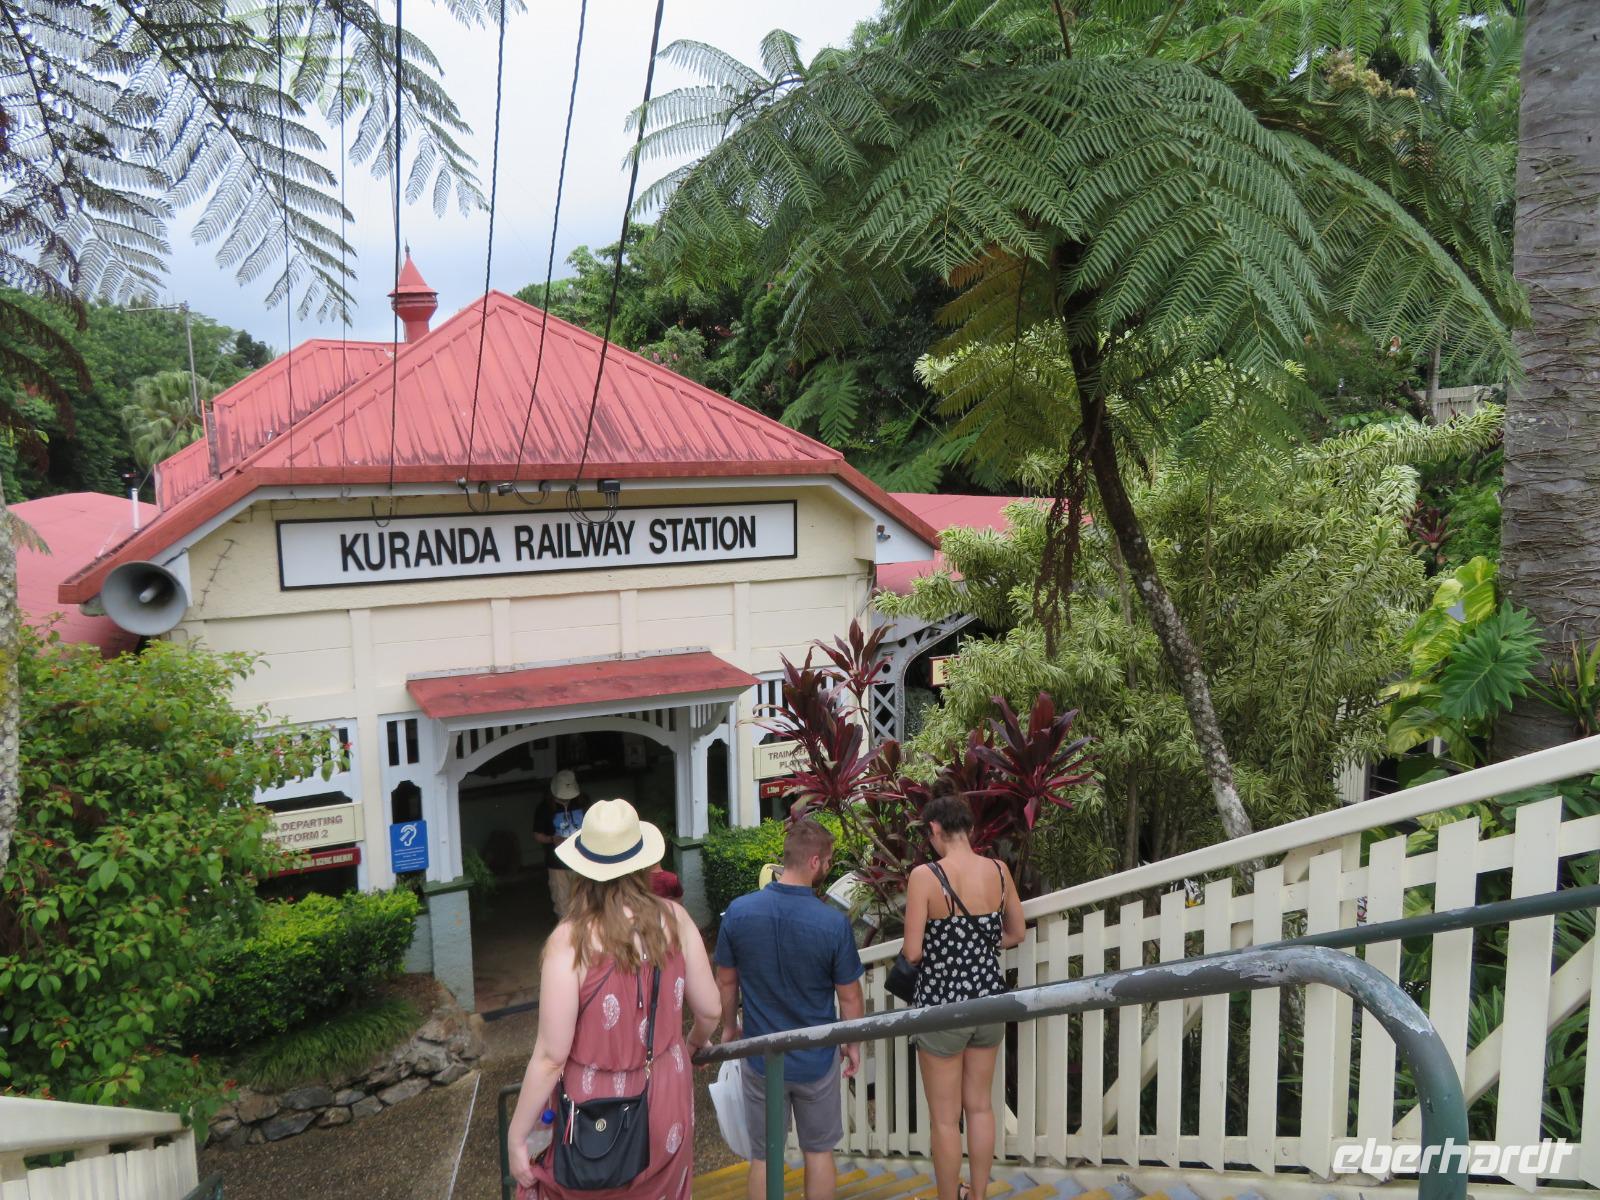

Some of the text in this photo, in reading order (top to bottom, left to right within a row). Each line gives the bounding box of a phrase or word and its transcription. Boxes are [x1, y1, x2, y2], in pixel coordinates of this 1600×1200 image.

[340, 515, 756, 572] KURANDA RAILWAY STATION
[281, 815, 343, 831] DEPARTING
[321, 829, 329, 838] 2
